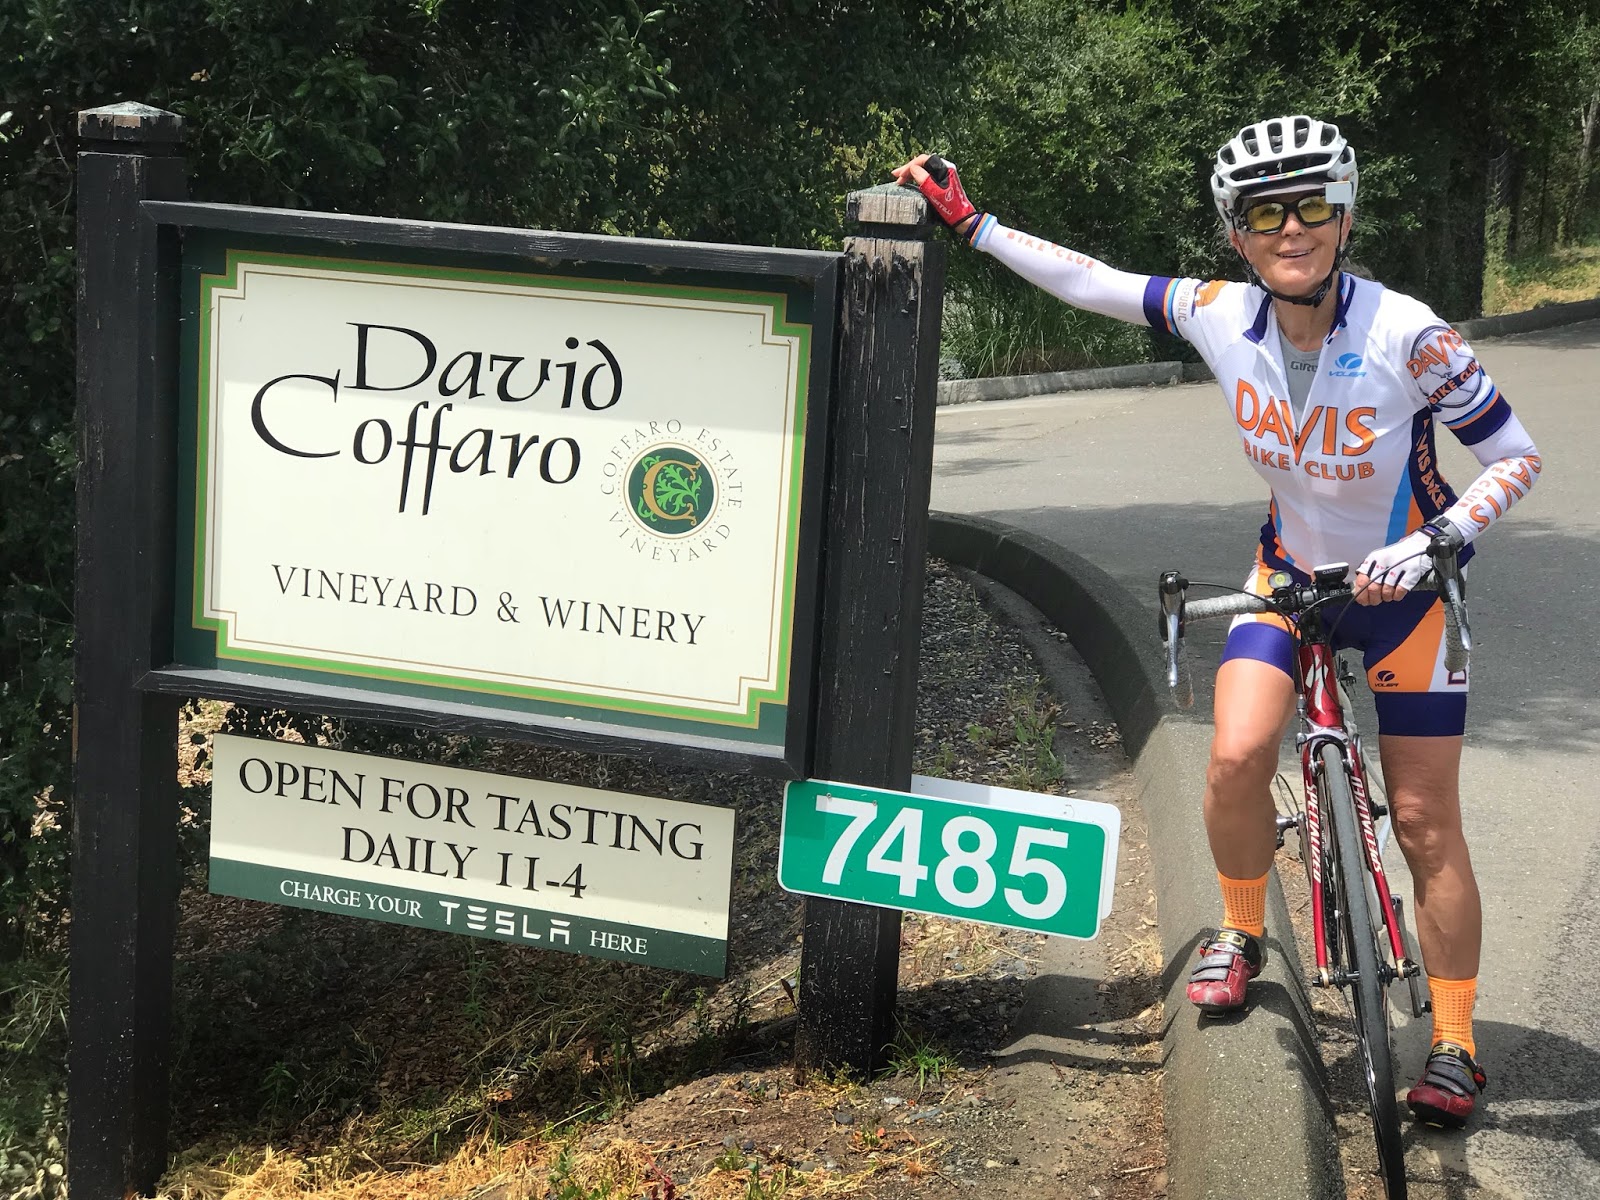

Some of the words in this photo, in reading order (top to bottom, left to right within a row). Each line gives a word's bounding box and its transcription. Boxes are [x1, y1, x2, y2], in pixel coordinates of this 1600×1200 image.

[1007, 231, 1046, 252] BIKE
[1056, 249, 1095, 269] CLUB
[343, 322, 623, 411] David
[1428, 380, 1458, 405] BIKE
[250, 368, 581, 516] Coffaro
[600, 418, 682, 495] COFFARO
[697, 428, 743, 509] ESTATE
[1235, 378, 1377, 466] DAVIS
[1243, 437, 1290, 471] BIKE
[1304, 460, 1376, 481] CLUB
[1469, 455, 1542, 533] DAVIS
[609, 511, 731, 563] VINEYARD
[272, 564, 477, 617] VINEYARD
[497, 592, 520, 624] &
[539, 596, 706, 645] WINERY
[239, 758, 365, 809] OPEN
[378, 777, 476, 828] FOR
[485, 792, 704, 860] TASTING
[1305, 779, 1322, 884] SPECIALIZED
[1350, 775, 1384, 876] SPECIALIZED
[341, 826, 478, 880] DAILY
[815, 794, 1069, 920] 7485
[279, 879, 362, 908] CHARGE
[364, 892, 424, 919] YOUR
[438, 900, 571, 945] TESLA
[589, 929, 648, 955] HERE
